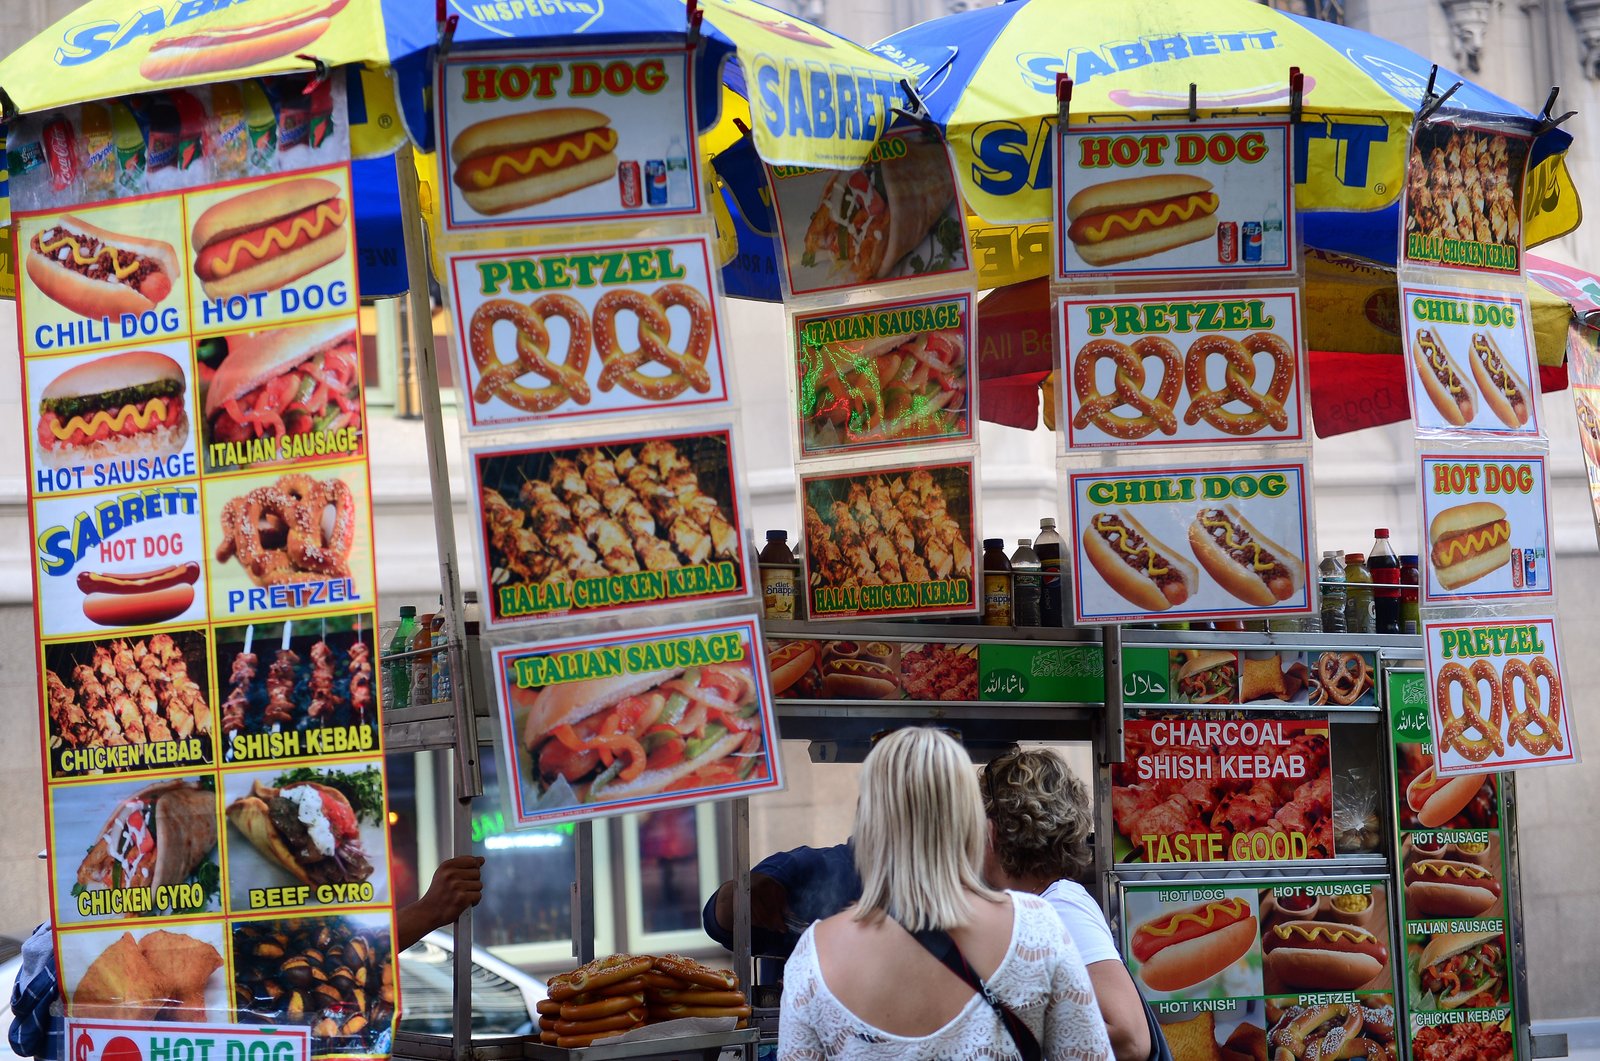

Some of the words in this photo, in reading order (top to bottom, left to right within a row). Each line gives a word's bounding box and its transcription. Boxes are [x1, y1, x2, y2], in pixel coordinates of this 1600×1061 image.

[1016, 28, 1278, 94] SABRETT
[463, 62, 564, 102] HOT
[568, 59, 669, 96] DOG
[1078, 135, 1169, 168] HOT
[1174, 132, 1269, 165] DOG
[1408, 234, 1442, 261] HALAL
[1442, 238, 1484, 267] CHICKEN
[1485, 241, 1517, 270] KEBAB
[477, 247, 685, 296] PRETZEL
[203, 291, 268, 325] HOT
[282, 280, 347, 314] DOG
[1087, 300, 1275, 336] PRETZEL
[1413, 297, 1469, 324] CHILI
[1473, 304, 1516, 330] DOG
[35, 316, 109, 350] CHILI
[121, 307, 180, 339] DOG
[805, 315, 876, 347] ITALIAN
[877, 302, 961, 336] SAUSAGE
[209, 436, 276, 468] ITALIAN
[282, 426, 358, 455] SAUSAGE
[37, 465, 90, 492] HOT
[94, 453, 196, 486] SAUSAGE
[1086, 477, 1196, 506] CHILI
[1200, 473, 1290, 503] DOG
[1432, 464, 1480, 494] HOT
[1484, 464, 1535, 494] DOG
[38, 486, 199, 577] SABRETT
[100, 539, 137, 563] HOT
[143, 533, 183, 556] DOG
[229, 579, 361, 613] PRETZEL
[500, 583, 571, 616] HALAL
[571, 570, 665, 608] CHICKEN
[665, 561, 737, 596] KEBAB
[814, 585, 859, 613] HALAL
[859, 581, 918, 610] CHICKEN
[919, 578, 969, 607] KEBAB
[1440, 625, 1544, 660] PRETZEL
[515, 647, 623, 688] ITALIAN
[626, 632, 744, 671] SAUSAGE
[1124, 673, 1166, 697] حلال
[233, 730, 300, 761] SHISH
[306, 725, 374, 753] KEBAB
[1151, 722, 1291, 747] CHARCOAL
[60, 744, 143, 772] CHICKEN
[144, 739, 203, 764] KEBAB
[1137, 755, 1212, 780] SHISH
[1221, 755, 1306, 779] KEBAB
[1142, 832, 1224, 862] TASTE
[1231, 831, 1307, 862] GOOD
[1411, 832, 1435, 845] HOT
[1437, 830, 1489, 844] SAUSAGE
[78, 886, 152, 917] CHICKEN
[156, 883, 203, 911] GYRO
[249, 886, 310, 909] BEEF
[316, 881, 374, 904] GYRO
[1159, 890, 1189, 902] HOT
[1193, 889, 1225, 900] DOG
[1273, 886, 1303, 897] HOT
[1306, 884, 1372, 896] SAUSAGE
[1408, 922, 1448, 935] ITALIAN
[1451, 920, 1504, 933] SAUSAGE
[1159, 1001, 1191, 1014] HOT
[1193, 1000, 1236, 1012] KNISH
[1298, 993, 1361, 1006] PRETZEL
[1416, 1011, 1465, 1026] CHICKEN
[1467, 1009, 1505, 1022] KEBAB
[150, 1037, 215, 1061] HOT
[226, 1040, 294, 1061] DOG
